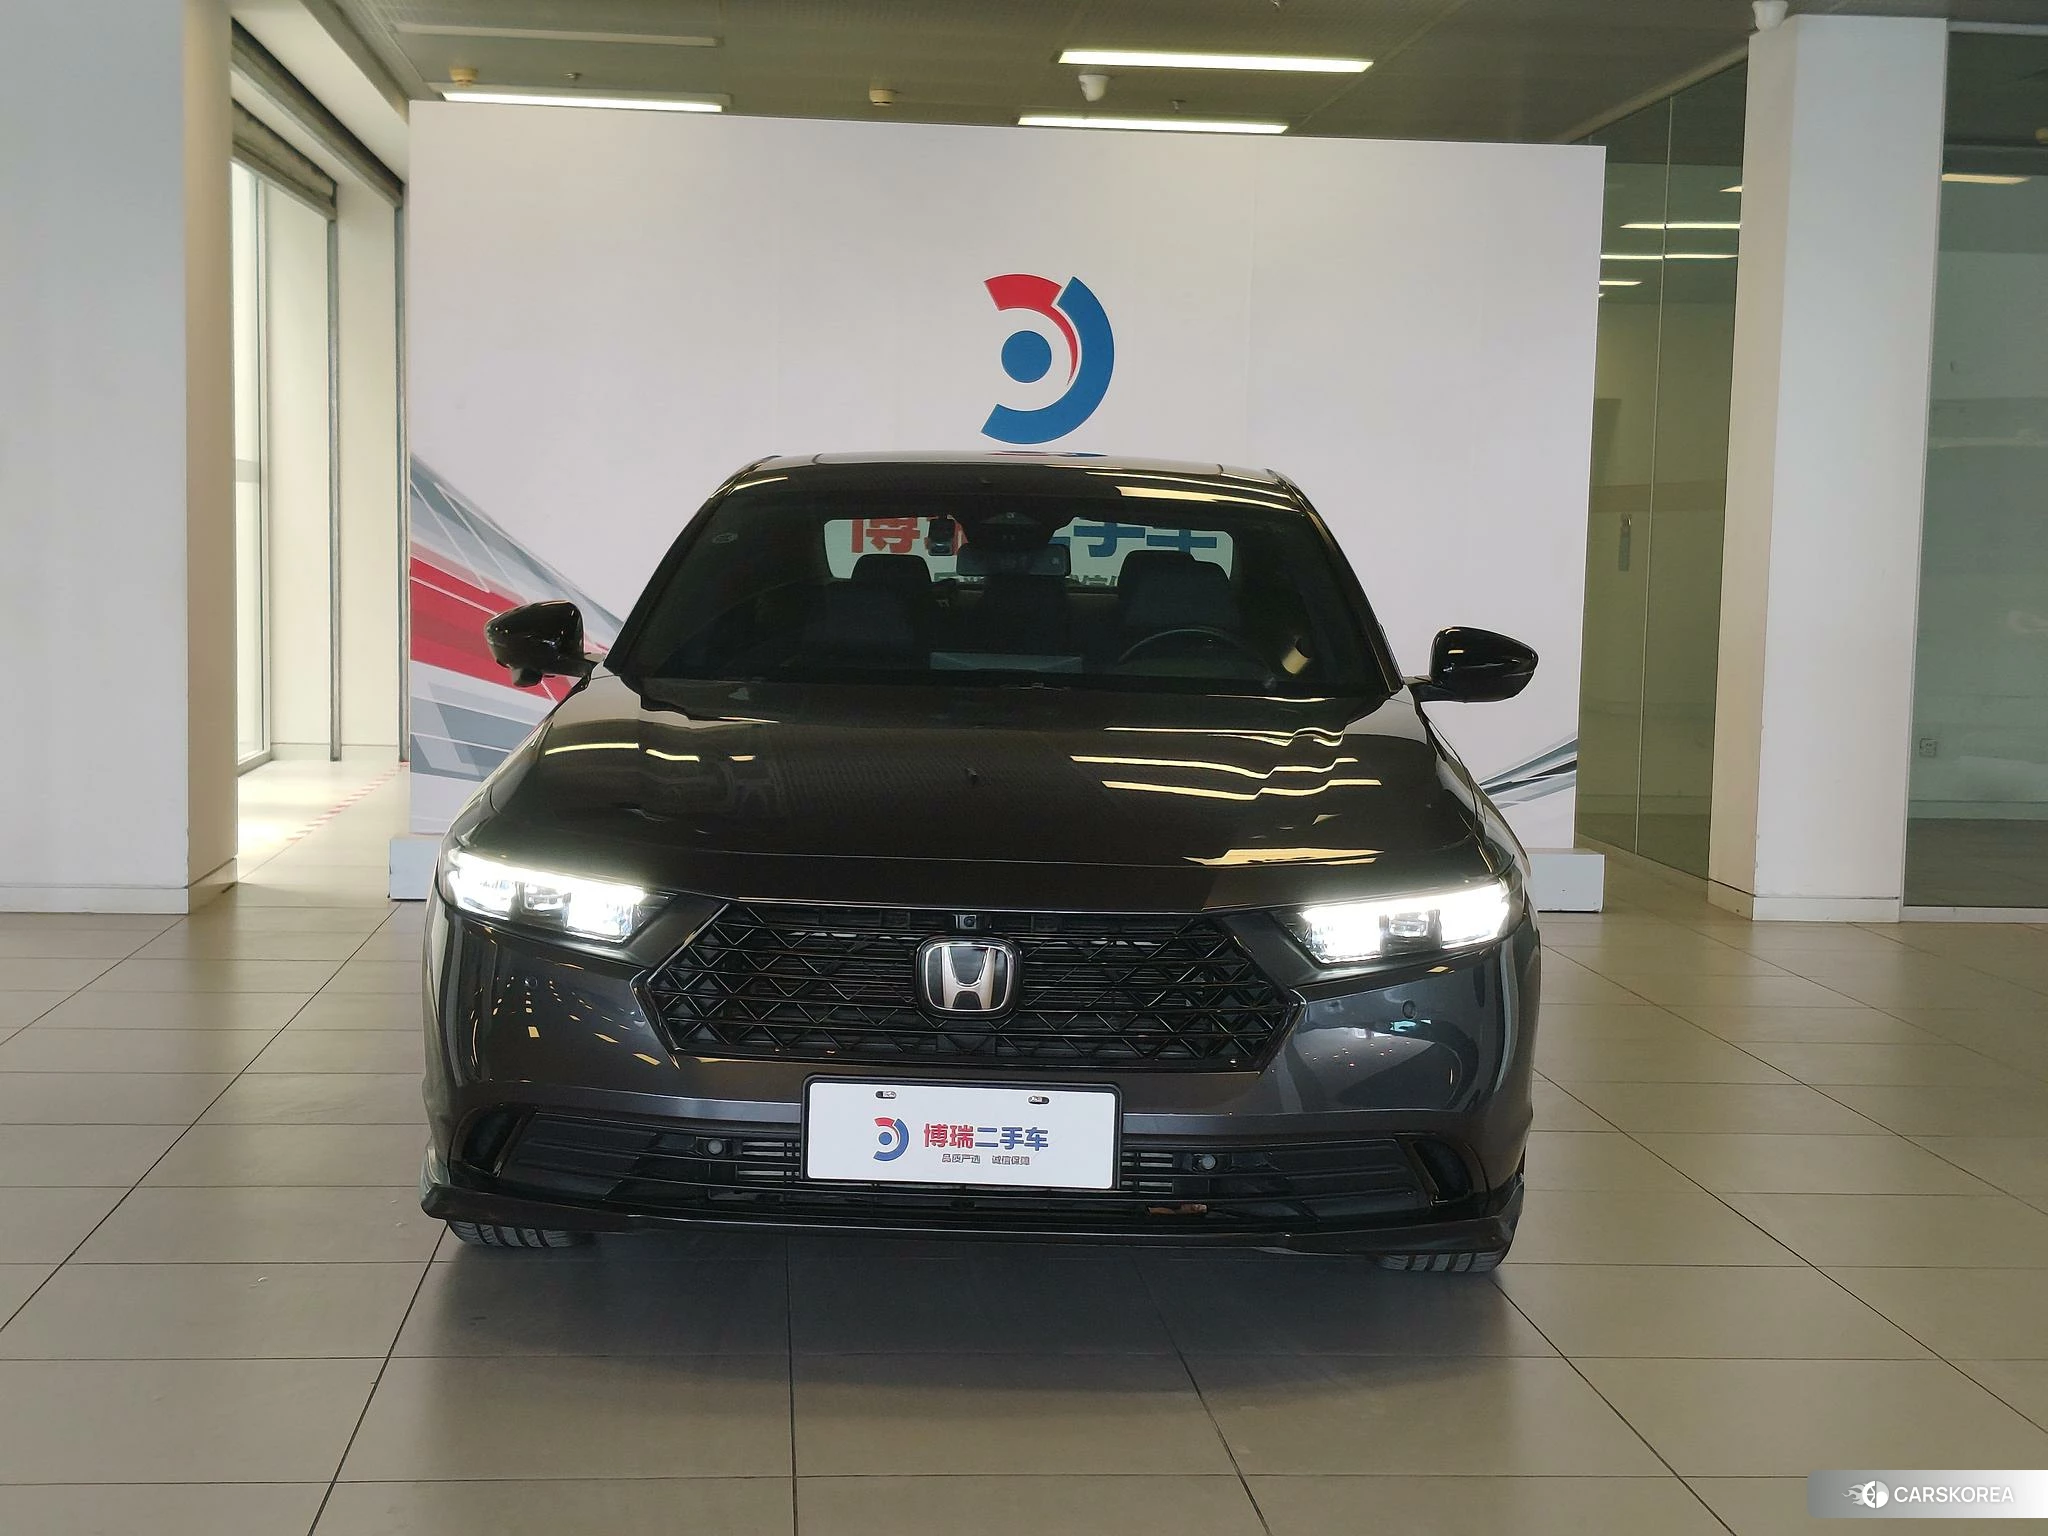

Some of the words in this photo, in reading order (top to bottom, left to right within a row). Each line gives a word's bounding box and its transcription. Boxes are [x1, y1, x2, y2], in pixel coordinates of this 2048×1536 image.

[924, 1123, 1049, 1151] 博瑞二手车
